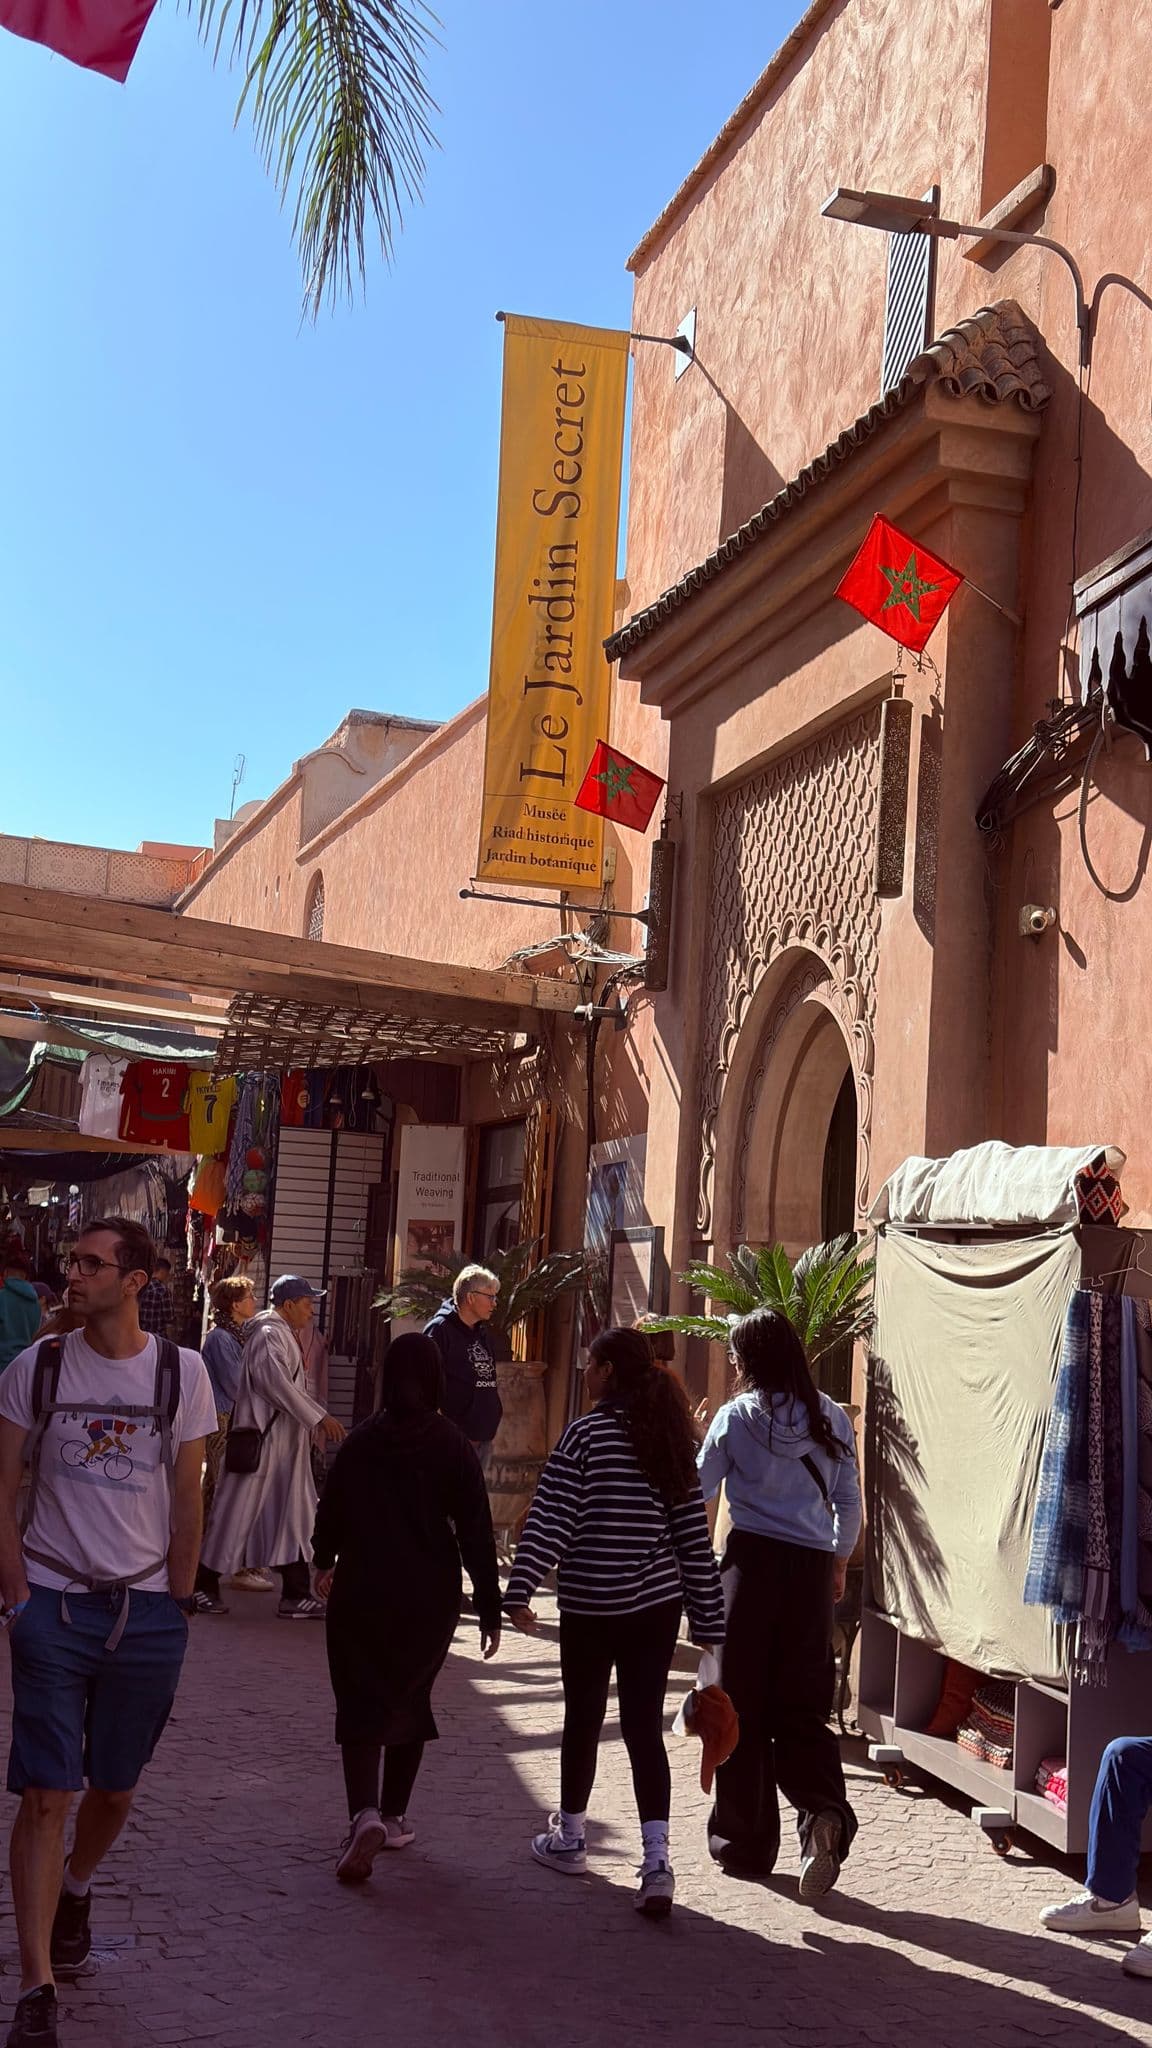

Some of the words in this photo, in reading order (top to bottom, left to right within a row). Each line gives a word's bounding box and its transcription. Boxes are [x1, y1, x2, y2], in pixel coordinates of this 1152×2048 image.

[532, 358, 587, 520] Secret
[523, 539, 583, 706] Jardin
[519, 713, 569, 788] Le
[492, 825, 524, 840] Riad
[526, 828, 595, 851] historique
[484, 848, 527, 864] Jardin
[530, 852, 597, 875] botanique
[161, 1077, 170, 1098] 2
[204, 1094, 217, 1124] 7
[411, 1171, 460, 1182] Traditional
[415, 1187, 454, 1200] Weaving
